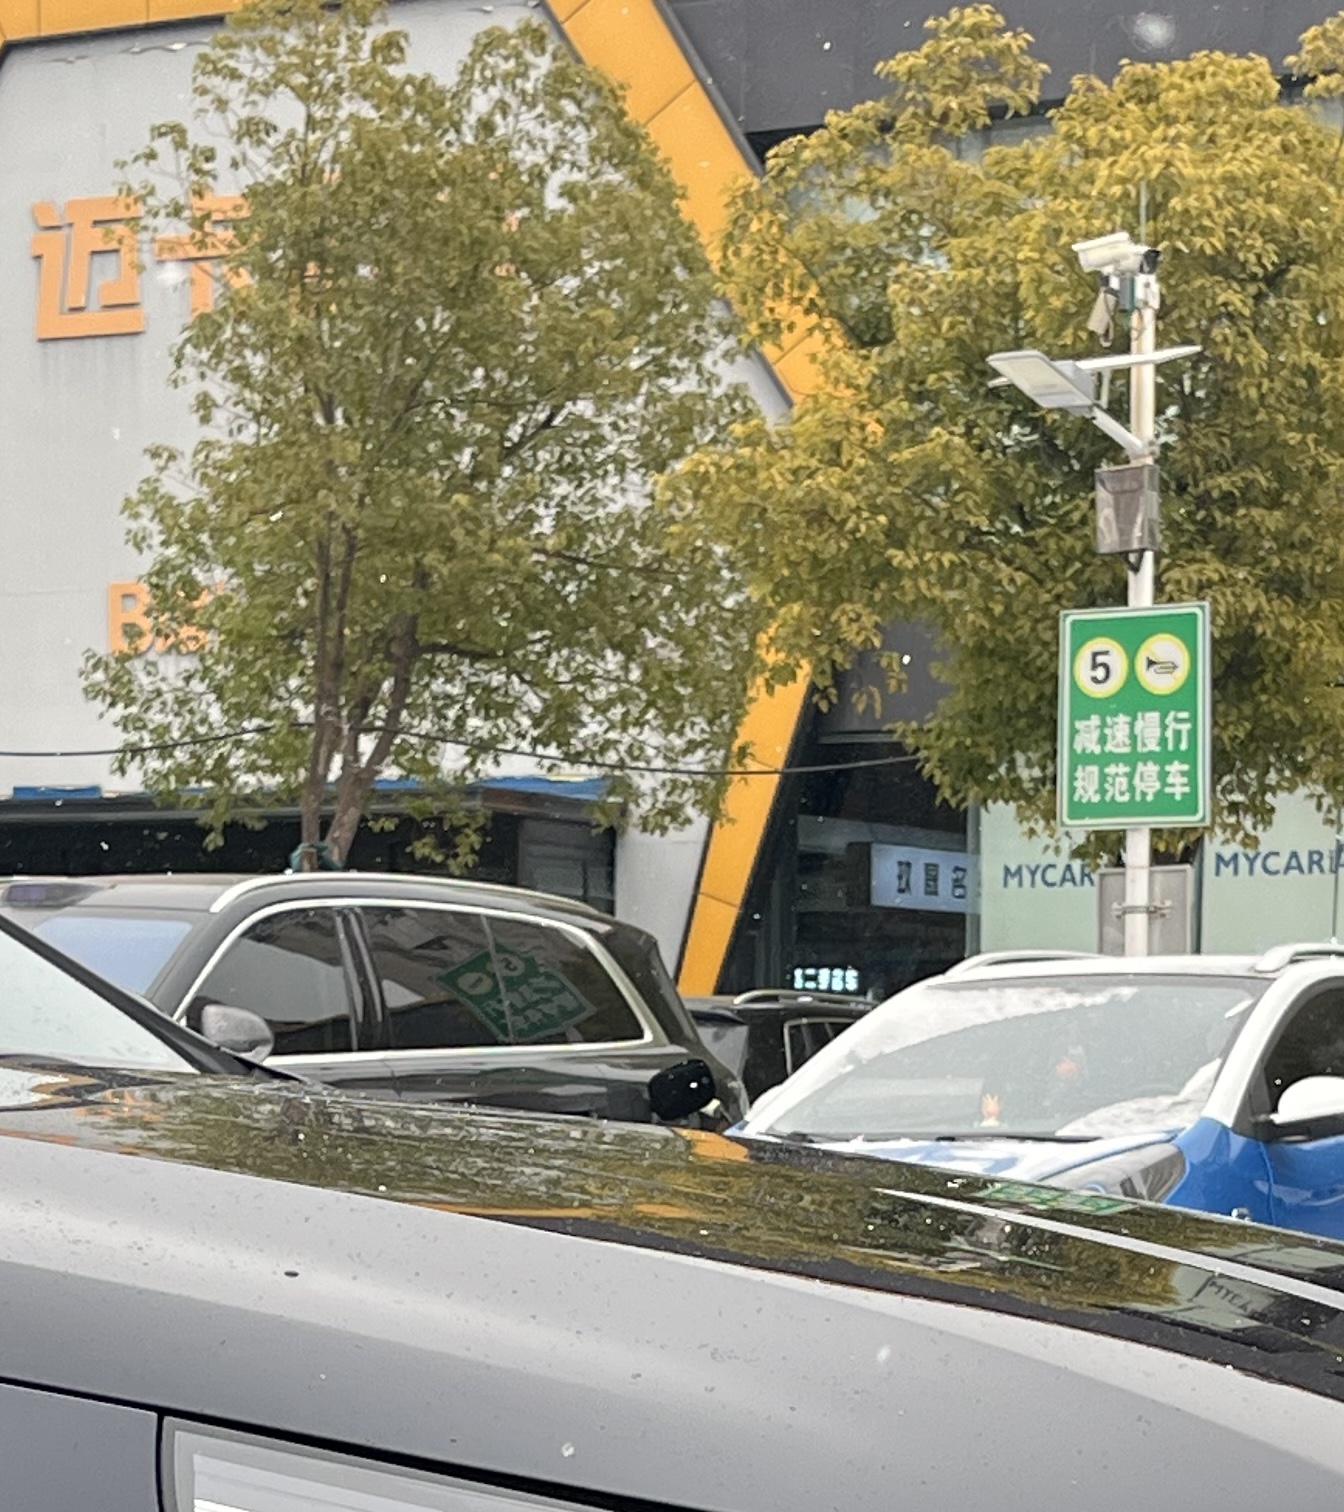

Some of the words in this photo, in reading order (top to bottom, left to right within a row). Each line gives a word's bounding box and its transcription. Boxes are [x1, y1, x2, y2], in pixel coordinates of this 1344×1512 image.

[1089, 650, 1112, 685] 5
[1073, 711, 1192, 755] 减速慢行
[1073, 760, 1191, 804] 规范停车
